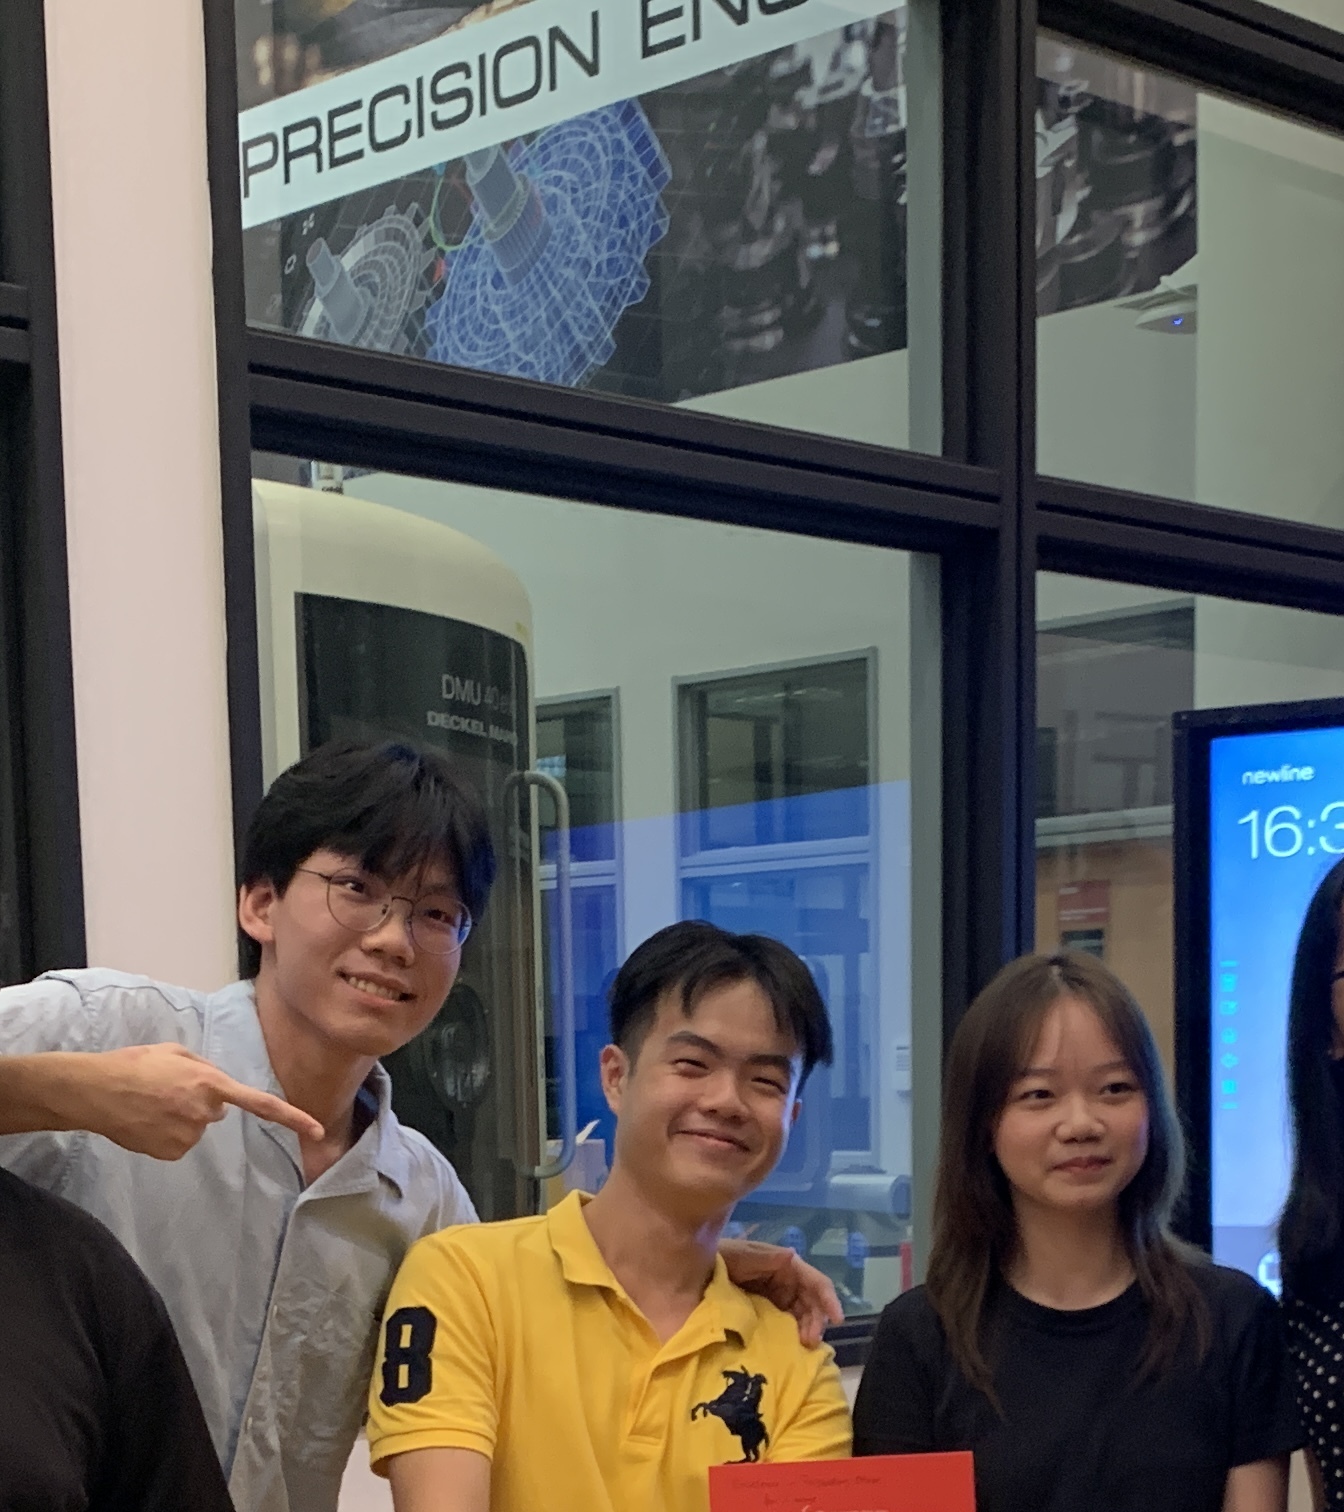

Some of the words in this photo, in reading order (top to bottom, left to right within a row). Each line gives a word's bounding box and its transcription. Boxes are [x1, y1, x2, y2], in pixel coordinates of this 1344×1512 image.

[242, 10, 600, 198] PRECISION
[442, 674, 481, 706] DMU
[1242, 764, 1315, 785] newline
[380, 1307, 437, 1407] 8
